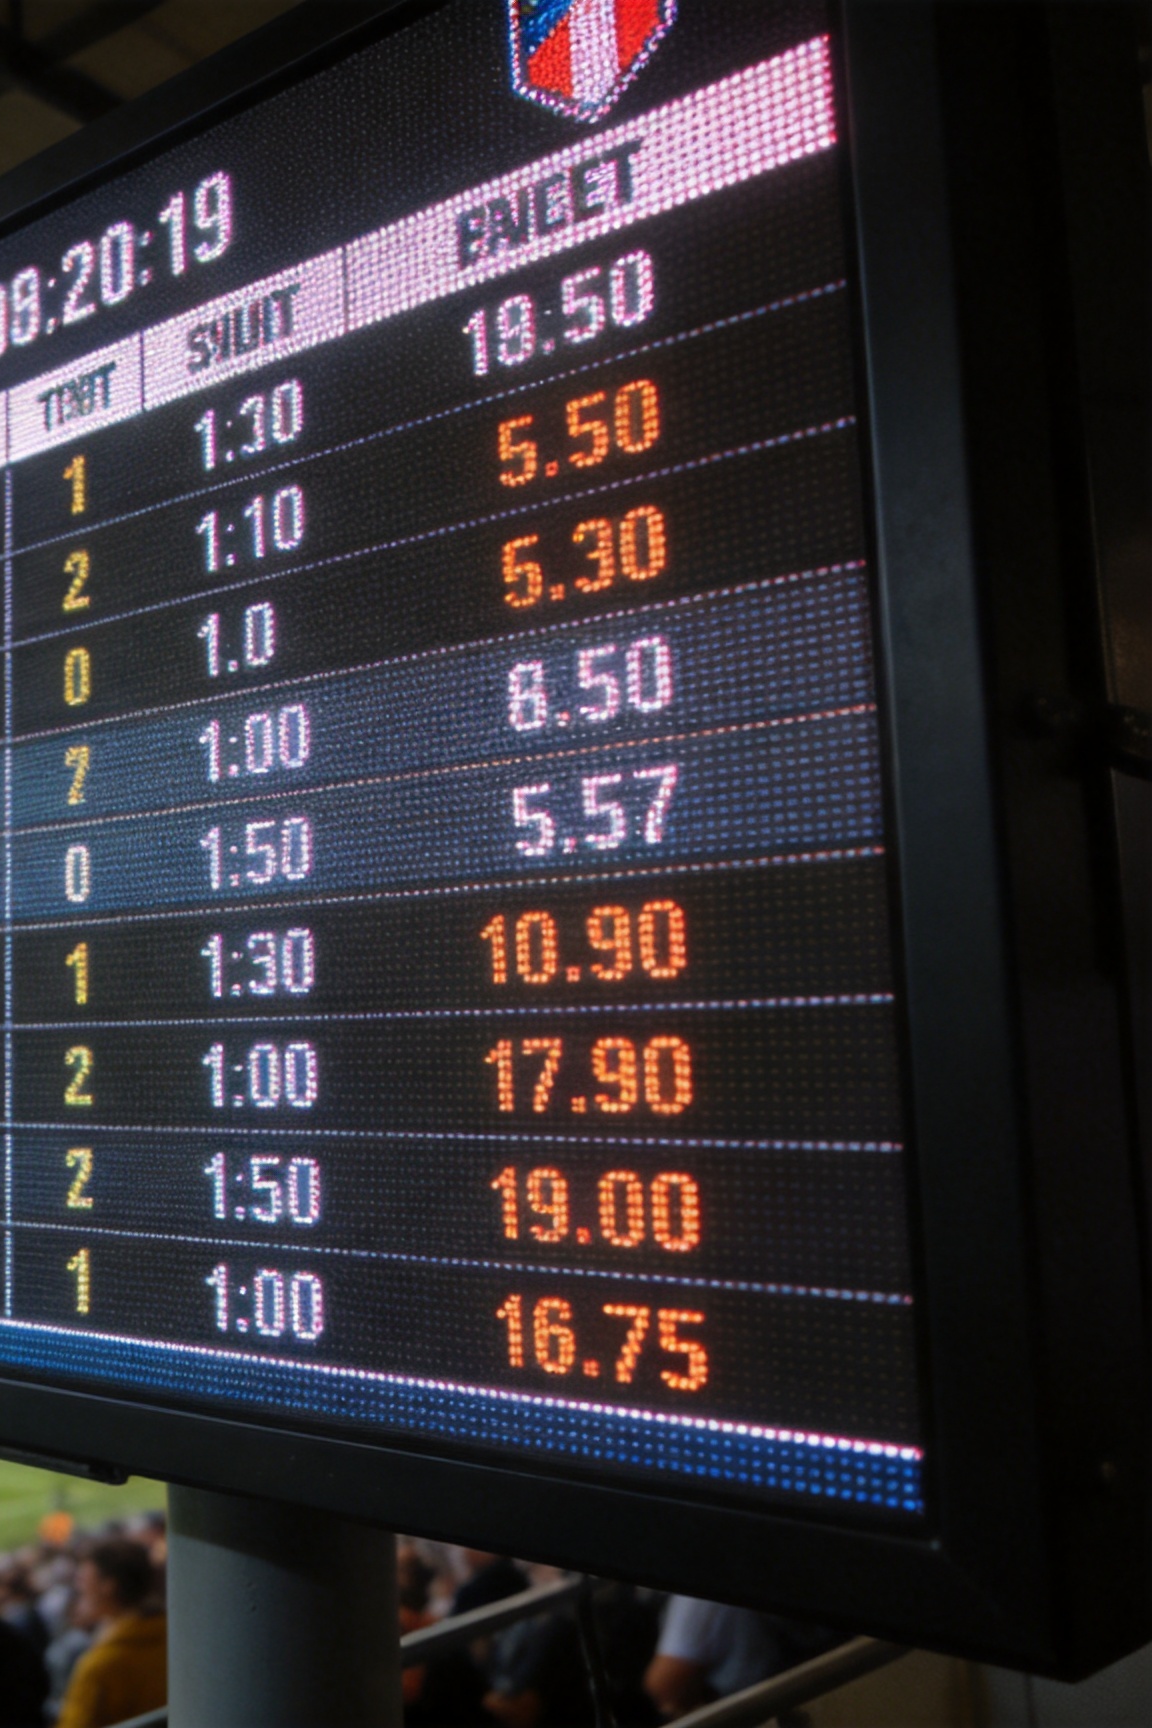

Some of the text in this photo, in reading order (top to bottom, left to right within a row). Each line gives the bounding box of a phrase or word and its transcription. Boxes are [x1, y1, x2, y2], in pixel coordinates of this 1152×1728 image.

[63, 455, 86, 514] 1
[194, 378, 304, 470] 1:30
[63, 550, 90, 612] 2
[196, 484, 305, 572] 1:10
[498, 379, 659, 488] 5.50
[64, 647, 90, 706] 0
[197, 601, 276, 677] 1.0
[502, 505, 666, 608] 5.30
[65, 745, 90, 805] 7
[198, 703, 311, 783] 1:00
[507, 634, 674, 732] 8.50
[65, 846, 90, 903] 0
[199, 816, 314, 890] 1:50
[512, 763, 679, 857] 5.57
[65, 941, 88, 1004] 1
[200, 927, 316, 998] 1:30
[480, 899, 687, 984] 10.90
[64, 1045, 93, 1105] 2
[202, 1042, 318, 1109] 1:00
[484, 1035, 693, 1114] 17.90
[65, 1148, 94, 1209] 2
[204, 1152, 321, 1226] 1:50
[490, 1165, 701, 1252] 19.00
[65, 1248, 90, 1314] 1
[205, 1262, 323, 1340] 1:00
[496, 1293, 709, 1391] 16.75
